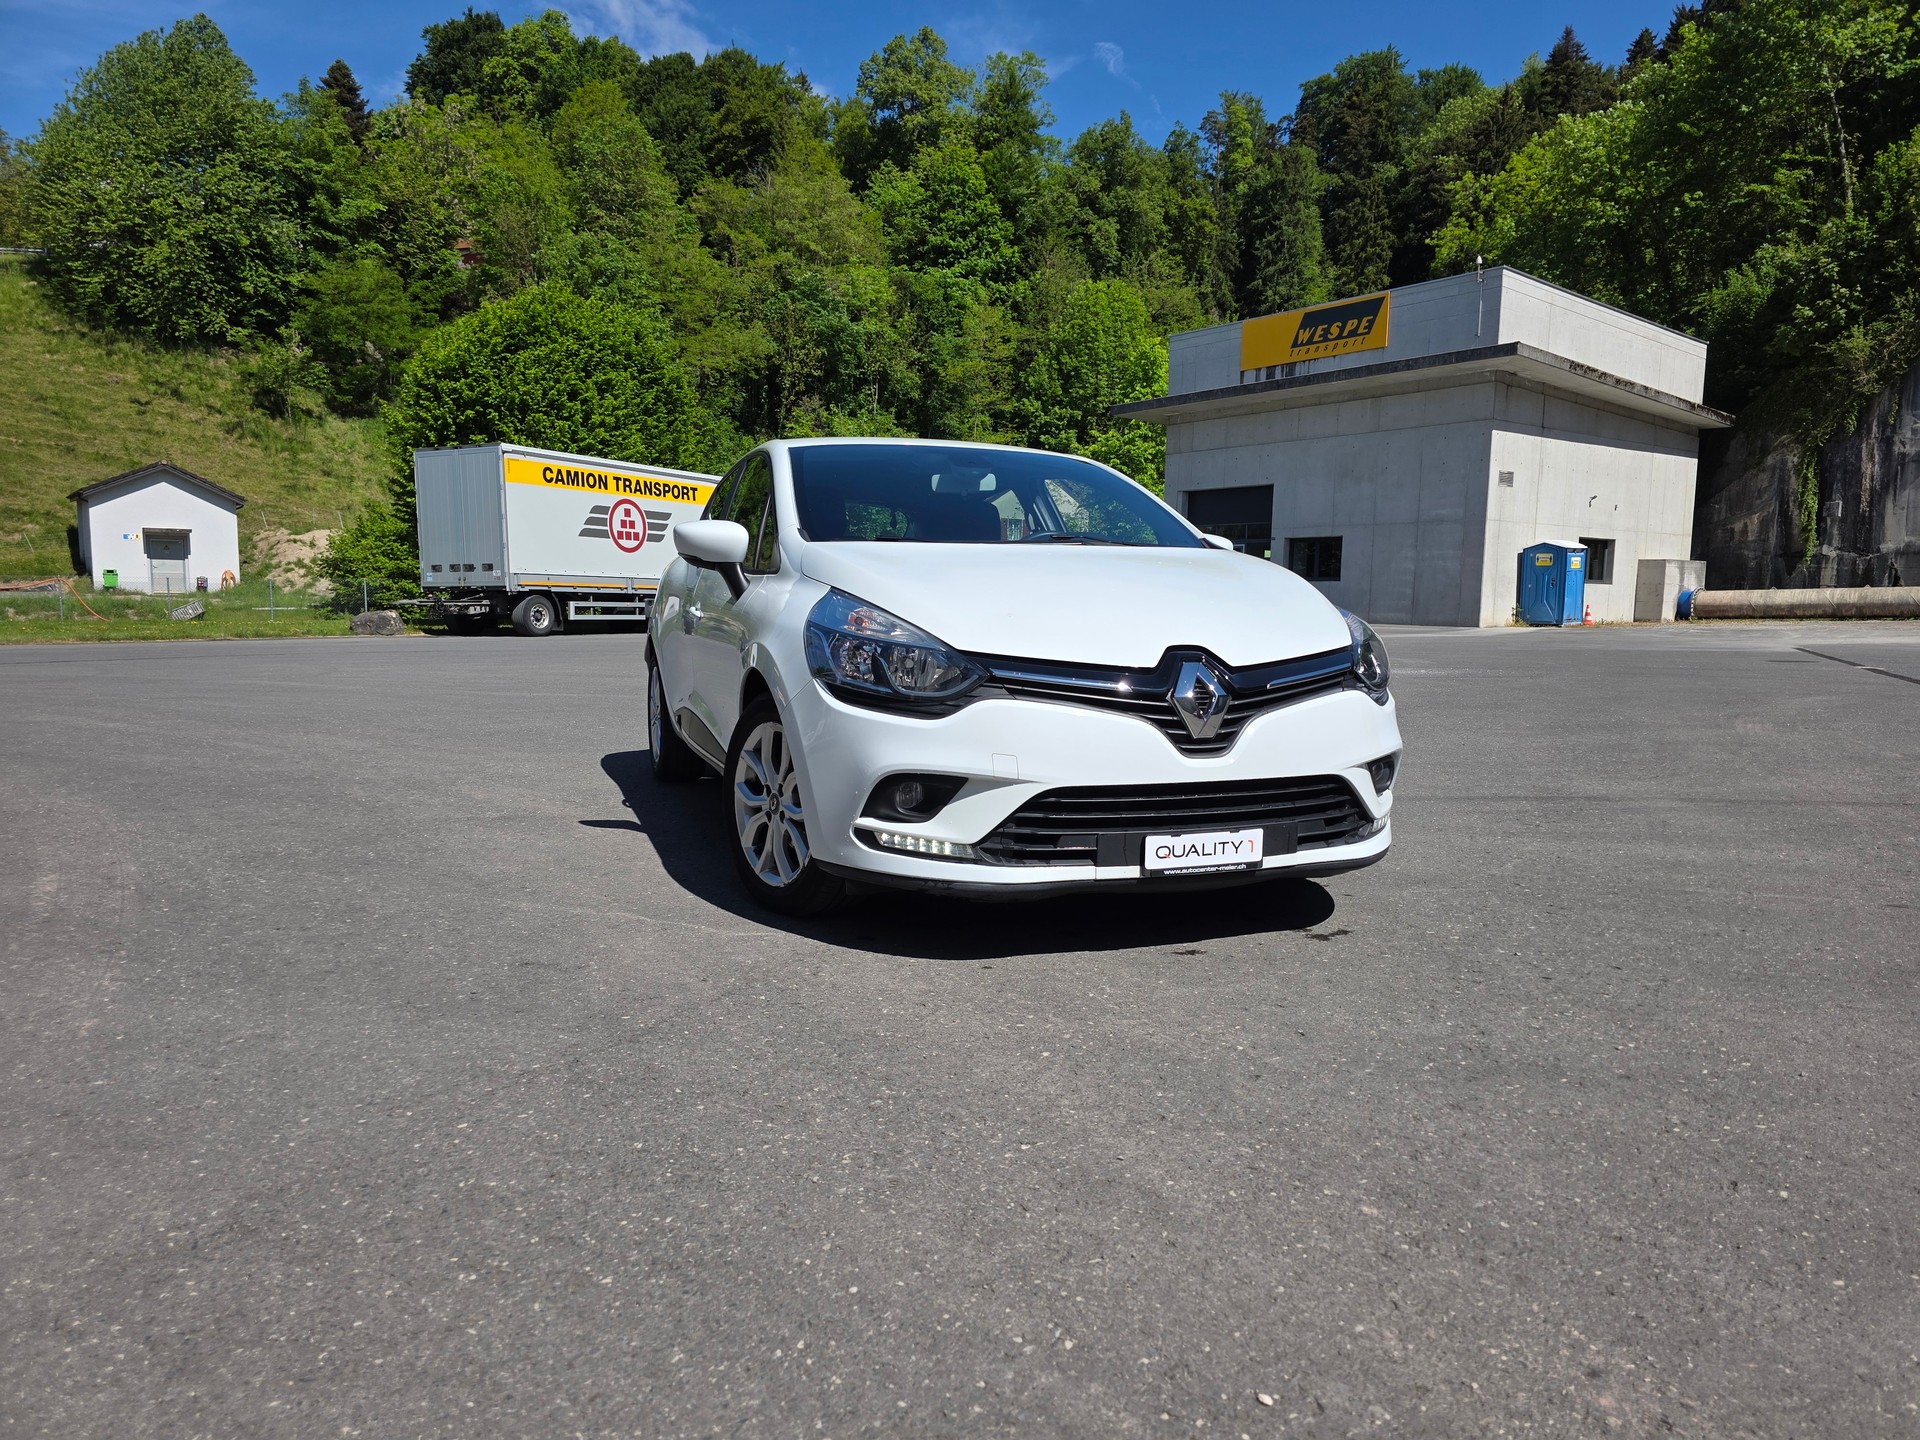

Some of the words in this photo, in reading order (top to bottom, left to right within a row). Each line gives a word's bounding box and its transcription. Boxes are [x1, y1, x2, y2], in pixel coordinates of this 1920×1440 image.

[1297, 315, 1374, 345] WESPE
[1289, 336, 1366, 358] transport
[542, 466, 609, 491] CAMION
[613, 476, 699, 502] TRANSPORT
[1163, 863, 1247, 875] www.autocenter-meier.ch
